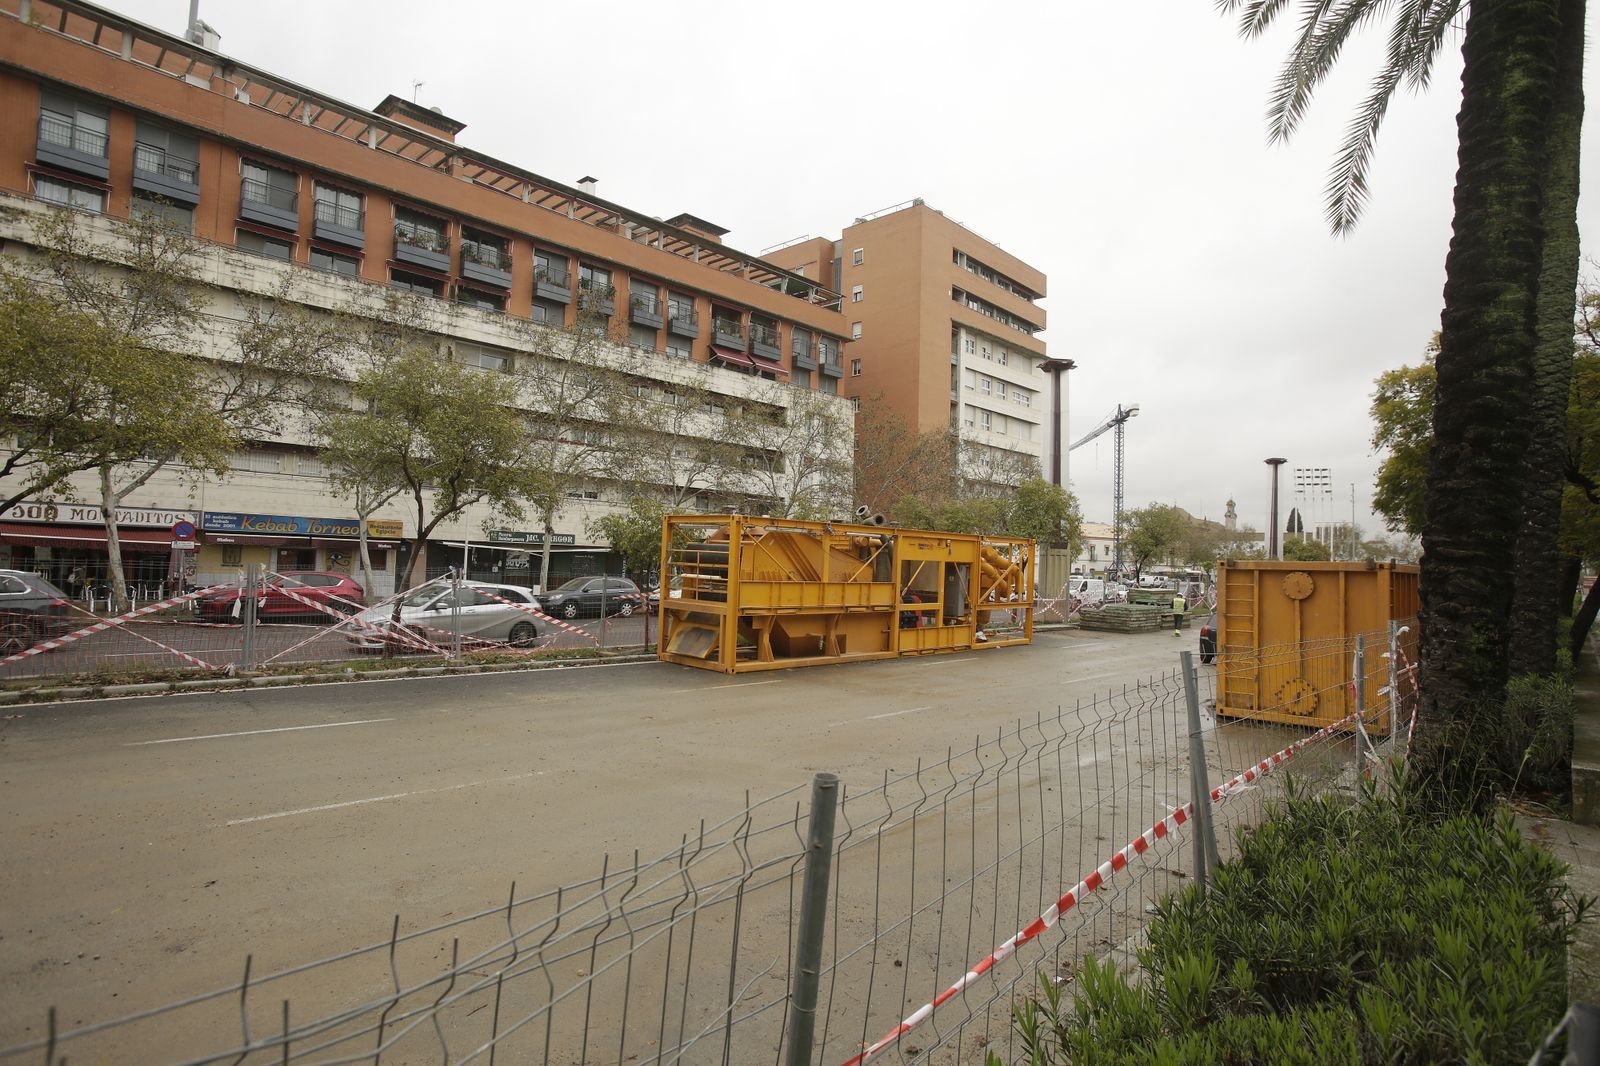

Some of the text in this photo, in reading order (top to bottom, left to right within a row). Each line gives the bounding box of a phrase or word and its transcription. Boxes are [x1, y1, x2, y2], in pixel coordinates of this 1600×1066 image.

[70, 508, 185, 523] MOTADITOS
[241, 515, 359, 535] Kebab Torneo
